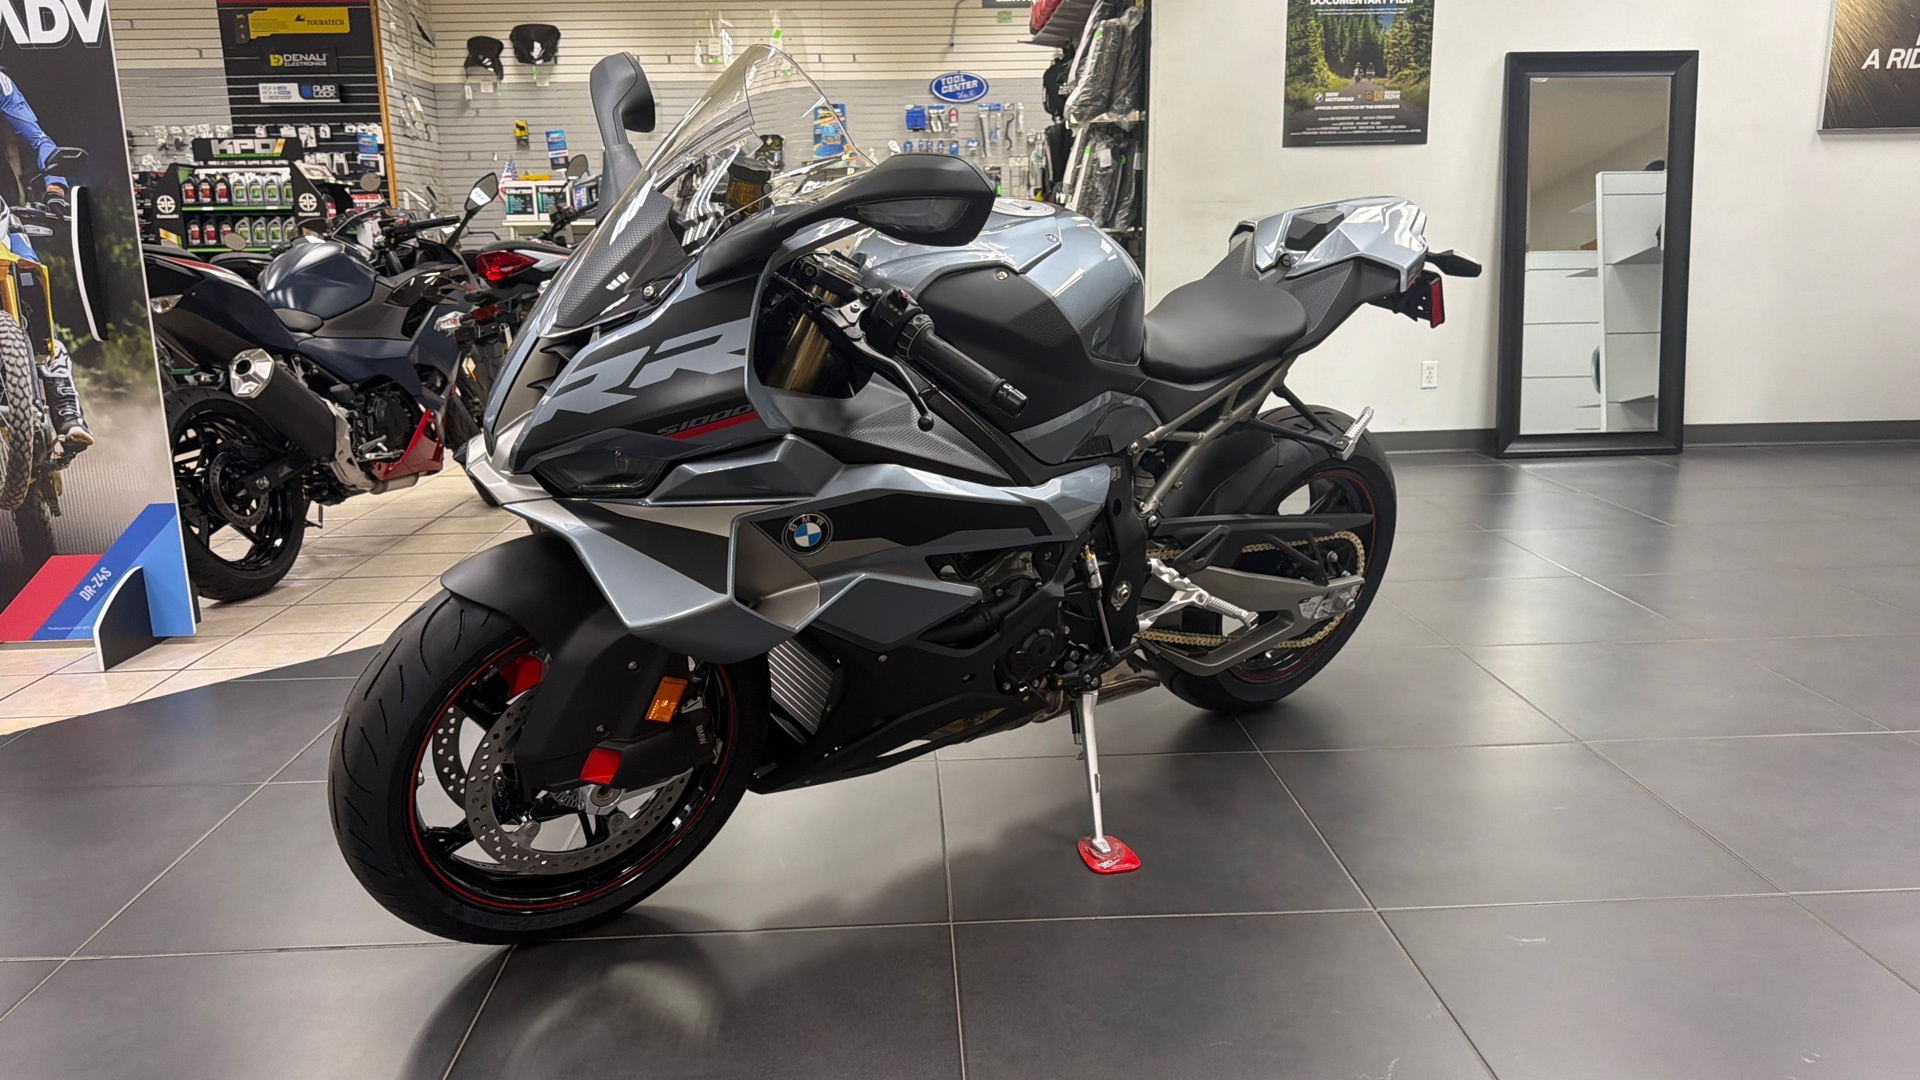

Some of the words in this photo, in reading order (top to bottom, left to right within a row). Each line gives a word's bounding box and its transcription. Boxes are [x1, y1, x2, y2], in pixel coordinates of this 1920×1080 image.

[283, 53, 327, 62] DENALI
[1861, 48, 1880, 69] A
[940, 74, 966, 86] TOOL
[941, 79, 978, 94] CENTER
[532, 317, 750, 429] RR
[788, 515, 826, 532] BMW
[78, 566, 112, 602] DR-Z4S
[695, 724, 708, 745] BMW
